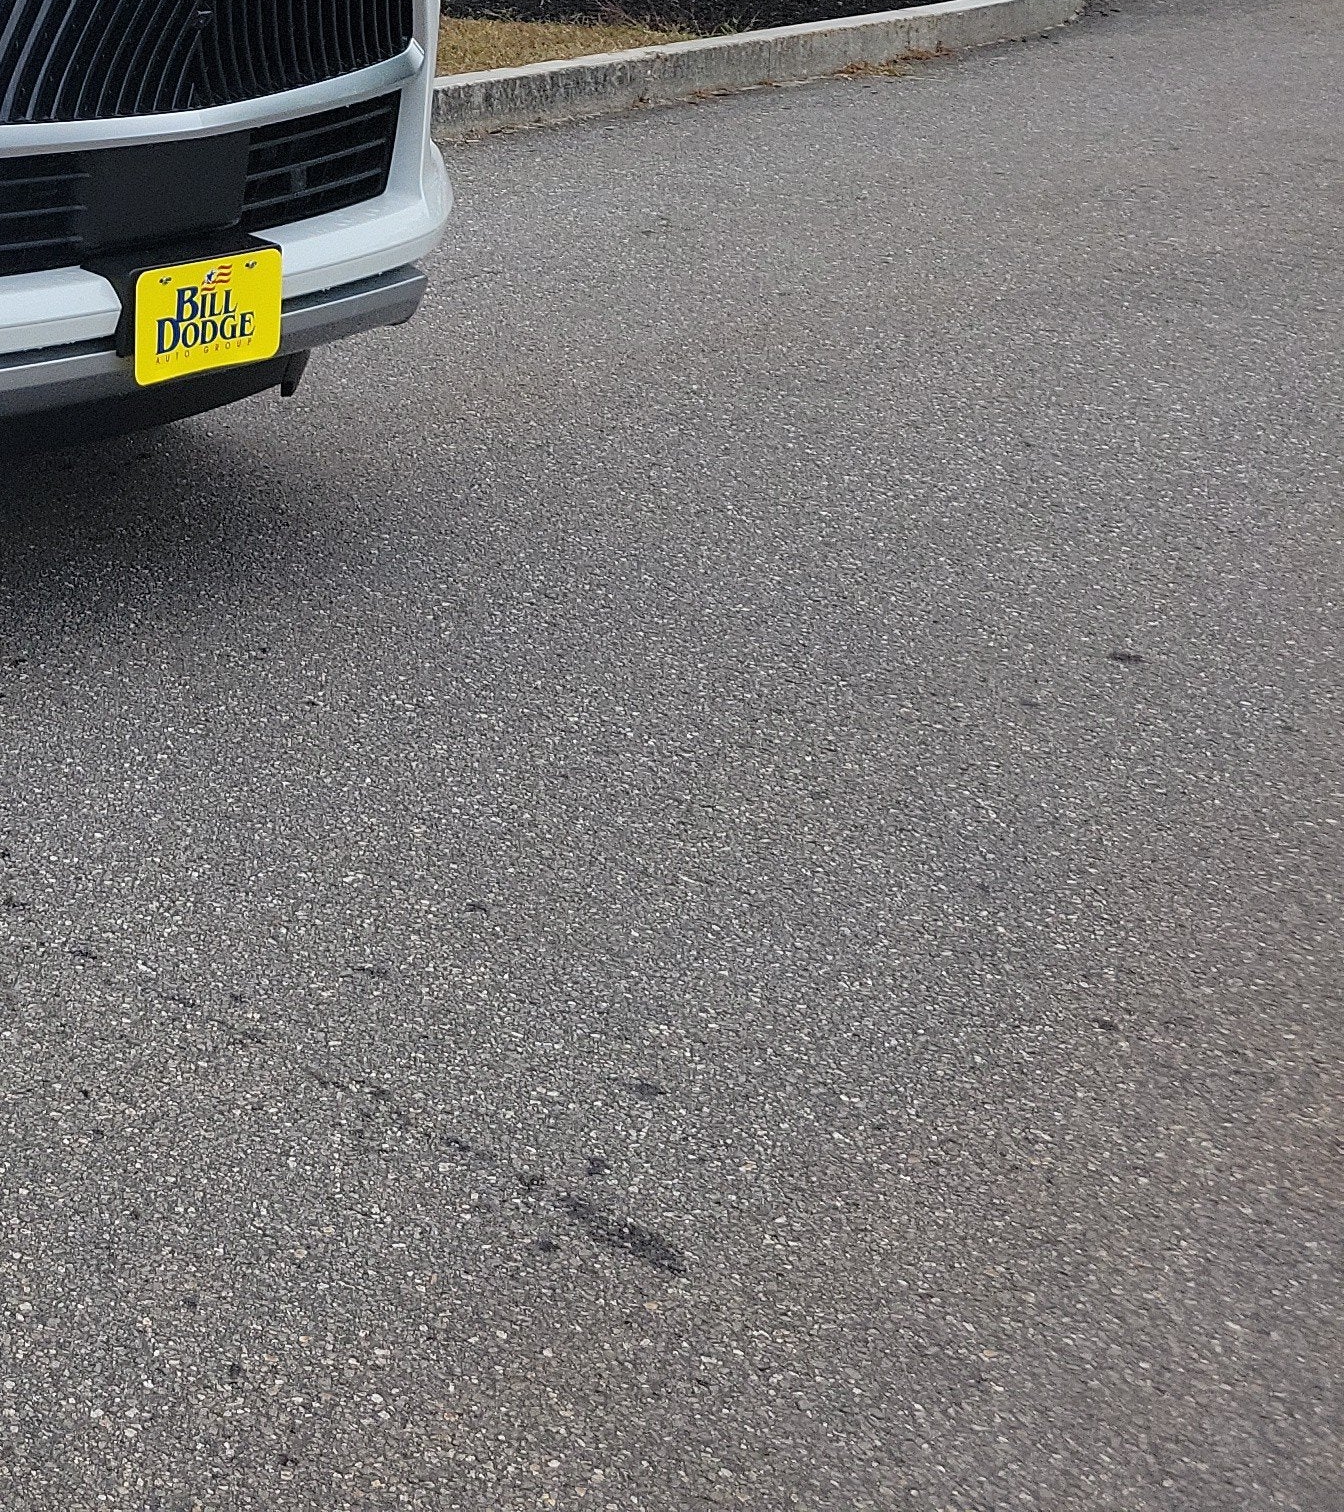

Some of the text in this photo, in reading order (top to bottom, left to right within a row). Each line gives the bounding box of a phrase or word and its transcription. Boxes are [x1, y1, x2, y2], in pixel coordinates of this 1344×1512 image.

[155, 286, 255, 355] BILL DODGE
[155, 338, 252, 364] AUTO GROUP
